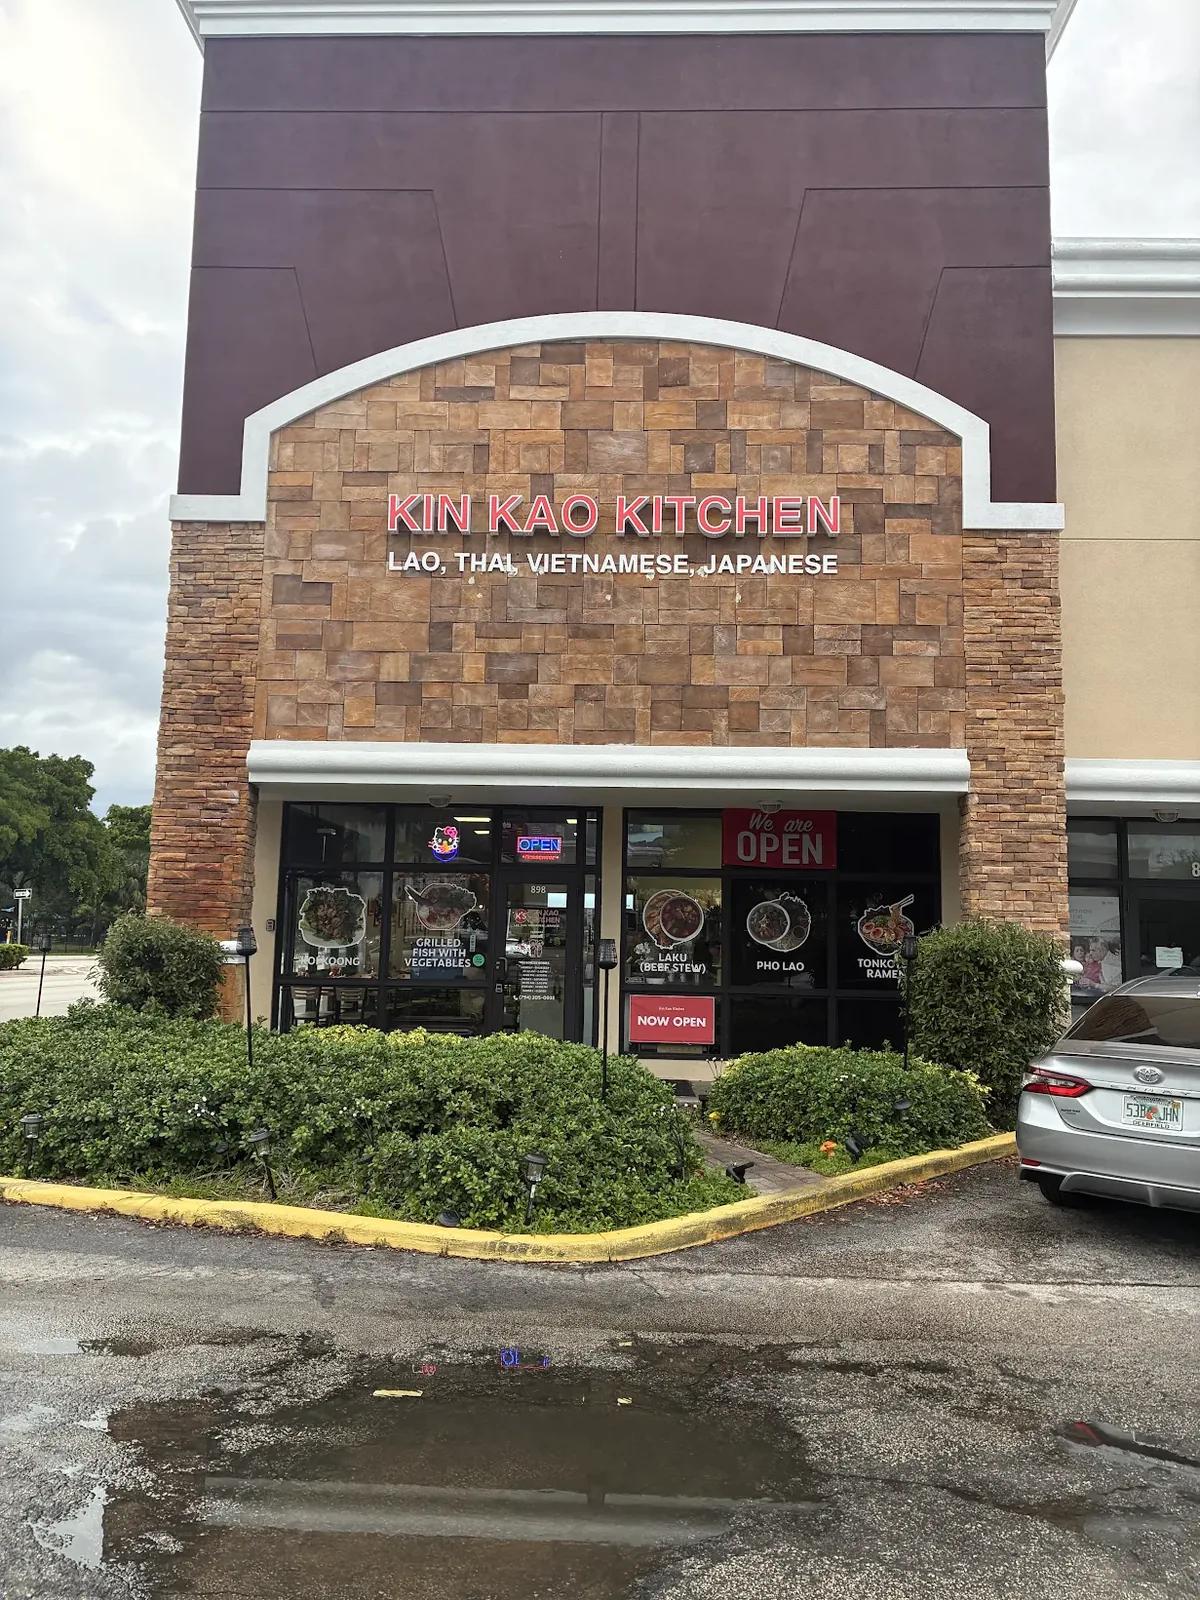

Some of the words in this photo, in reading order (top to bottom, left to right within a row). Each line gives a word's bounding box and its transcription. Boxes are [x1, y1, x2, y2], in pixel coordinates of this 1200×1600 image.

[386, 492, 471, 536] KIN
[488, 493, 599, 537] KAO
[614, 494, 841, 539] KITCHEN
[388, 551, 446, 575] LAO,
[527, 553, 695, 577] VIETNAMESE,
[706, 554, 838, 575] JAPANESE
[749, 812, 773, 831] We
[783, 819, 814, 833] are
[520, 839, 560, 851] OPEN
[737, 831, 823, 865] OPEN
[530, 885, 546, 894] 898
[416, 938, 461, 948] GRILLED
[412, 948, 436, 957] FISH
[438, 949, 466, 958] WITH
[658, 953, 687, 962] LAKU
[404, 958, 471, 968] VEGETABLES
[640, 962, 669, 973] (BEEF
[673, 963, 706, 974] STEW)
[756, 961, 780, 971] PHO
[782, 962, 805, 971] LAO
[637, 1016, 670, 1026] NOW
[673, 1016, 707, 1027] OPEN
[1126, 1103, 1146, 1118] 53B
[1159, 1107, 1179, 1122] JHN
